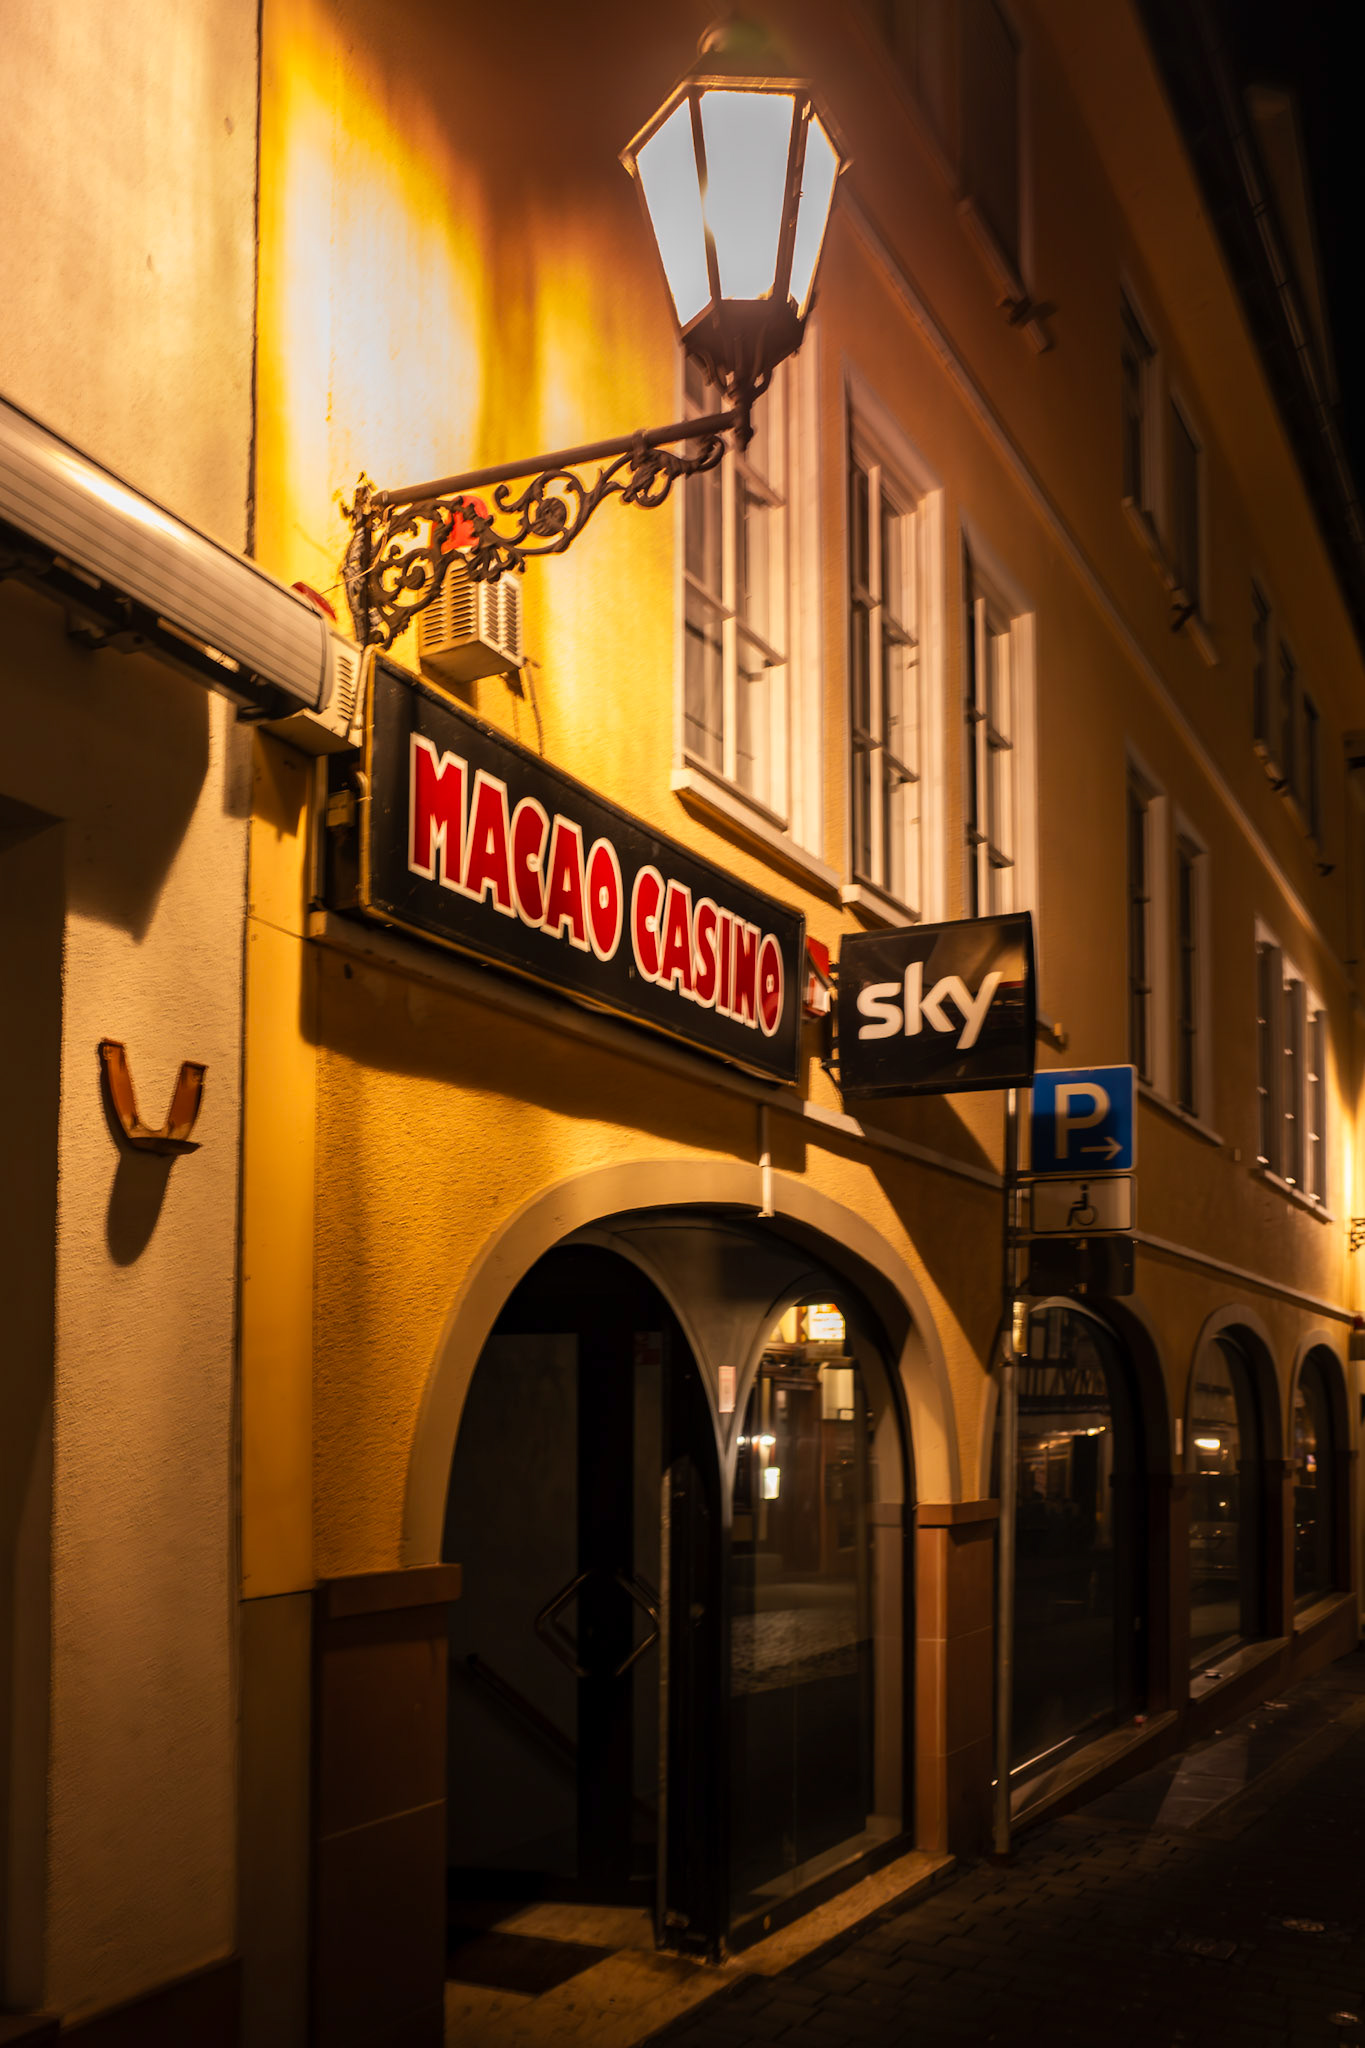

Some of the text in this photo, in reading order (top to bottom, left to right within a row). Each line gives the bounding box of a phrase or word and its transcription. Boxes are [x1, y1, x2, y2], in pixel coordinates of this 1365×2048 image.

[408, 731, 784, 1038] MACAO CASINO
[856, 961, 1004, 1050] sky
[1055, 1082, 1112, 1160] P
